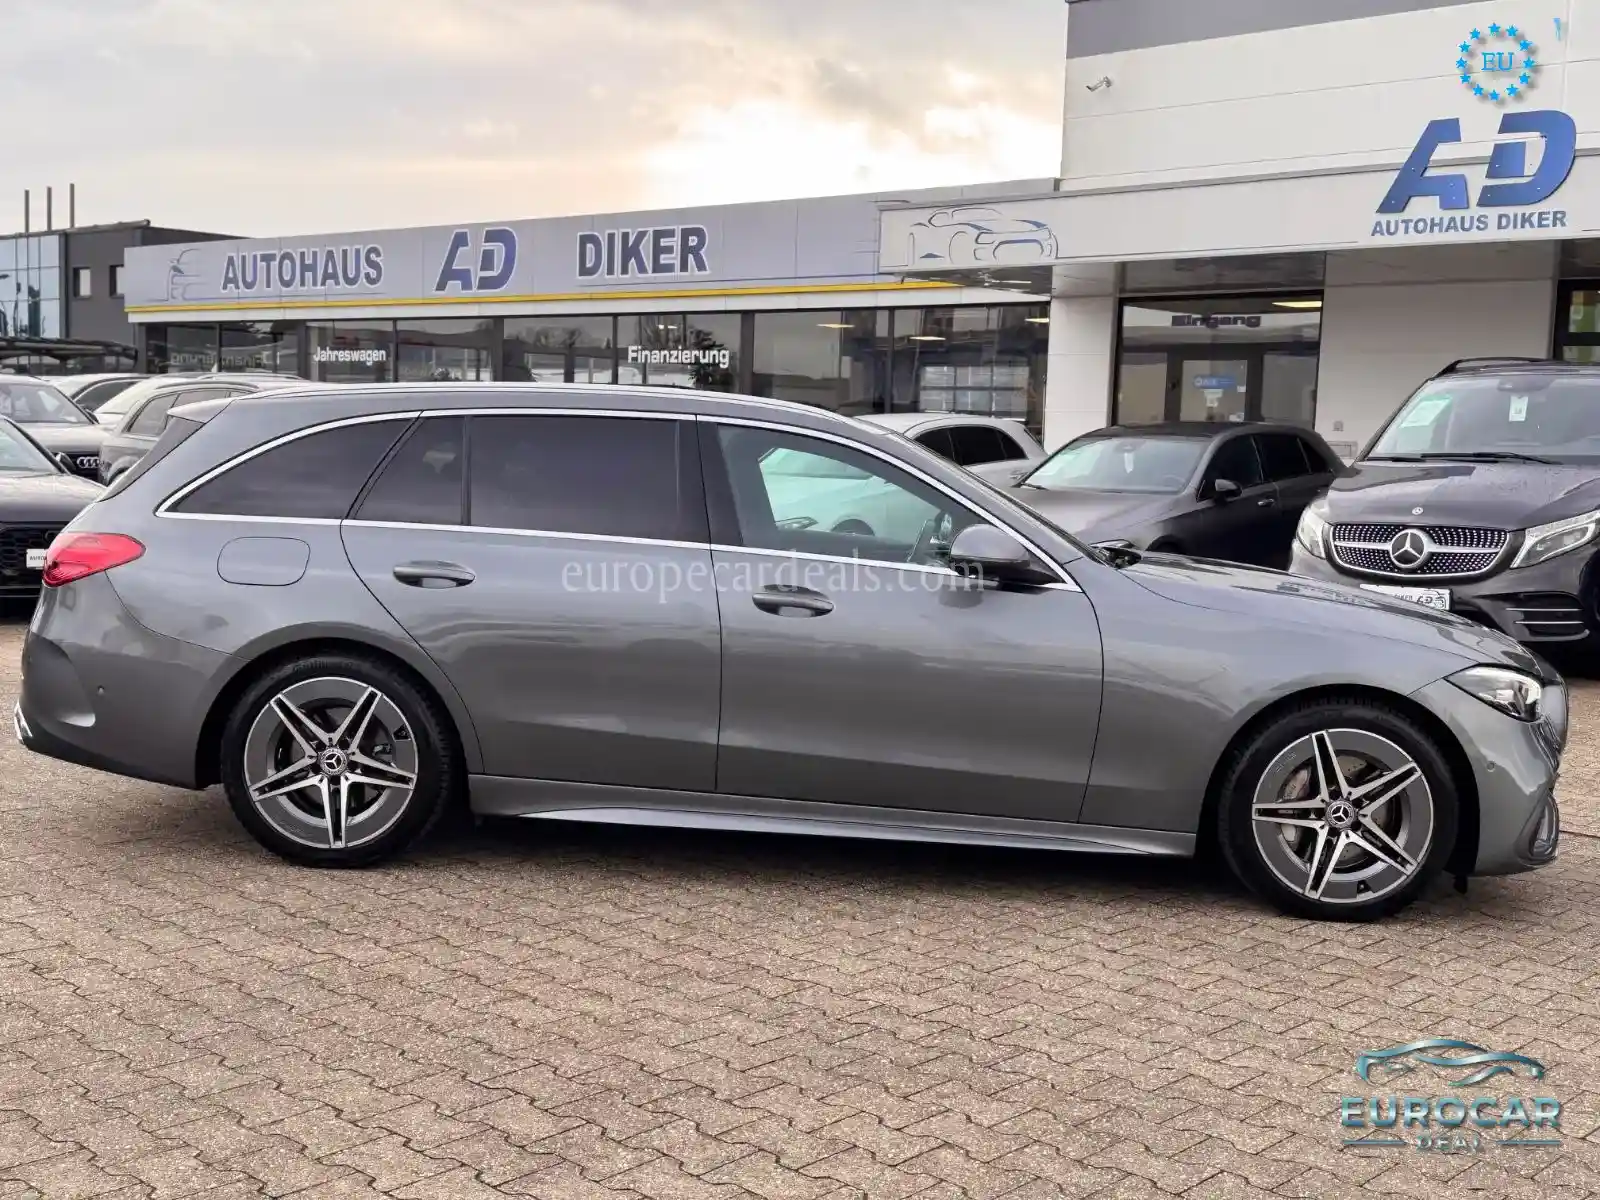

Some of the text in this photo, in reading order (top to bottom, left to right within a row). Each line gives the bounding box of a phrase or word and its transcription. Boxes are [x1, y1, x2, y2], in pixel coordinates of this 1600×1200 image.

[1376, 110, 1576, 213] AD
[1371, 210, 1567, 237] AUTOHAUS DIKER
[220, 224, 710, 293] AUTOHAUS AD DIKER
[1171, 314, 1262, 328] Eingang
[312, 346, 387, 366] Jahreswagen
[627, 345, 730, 368] Finanzierung
